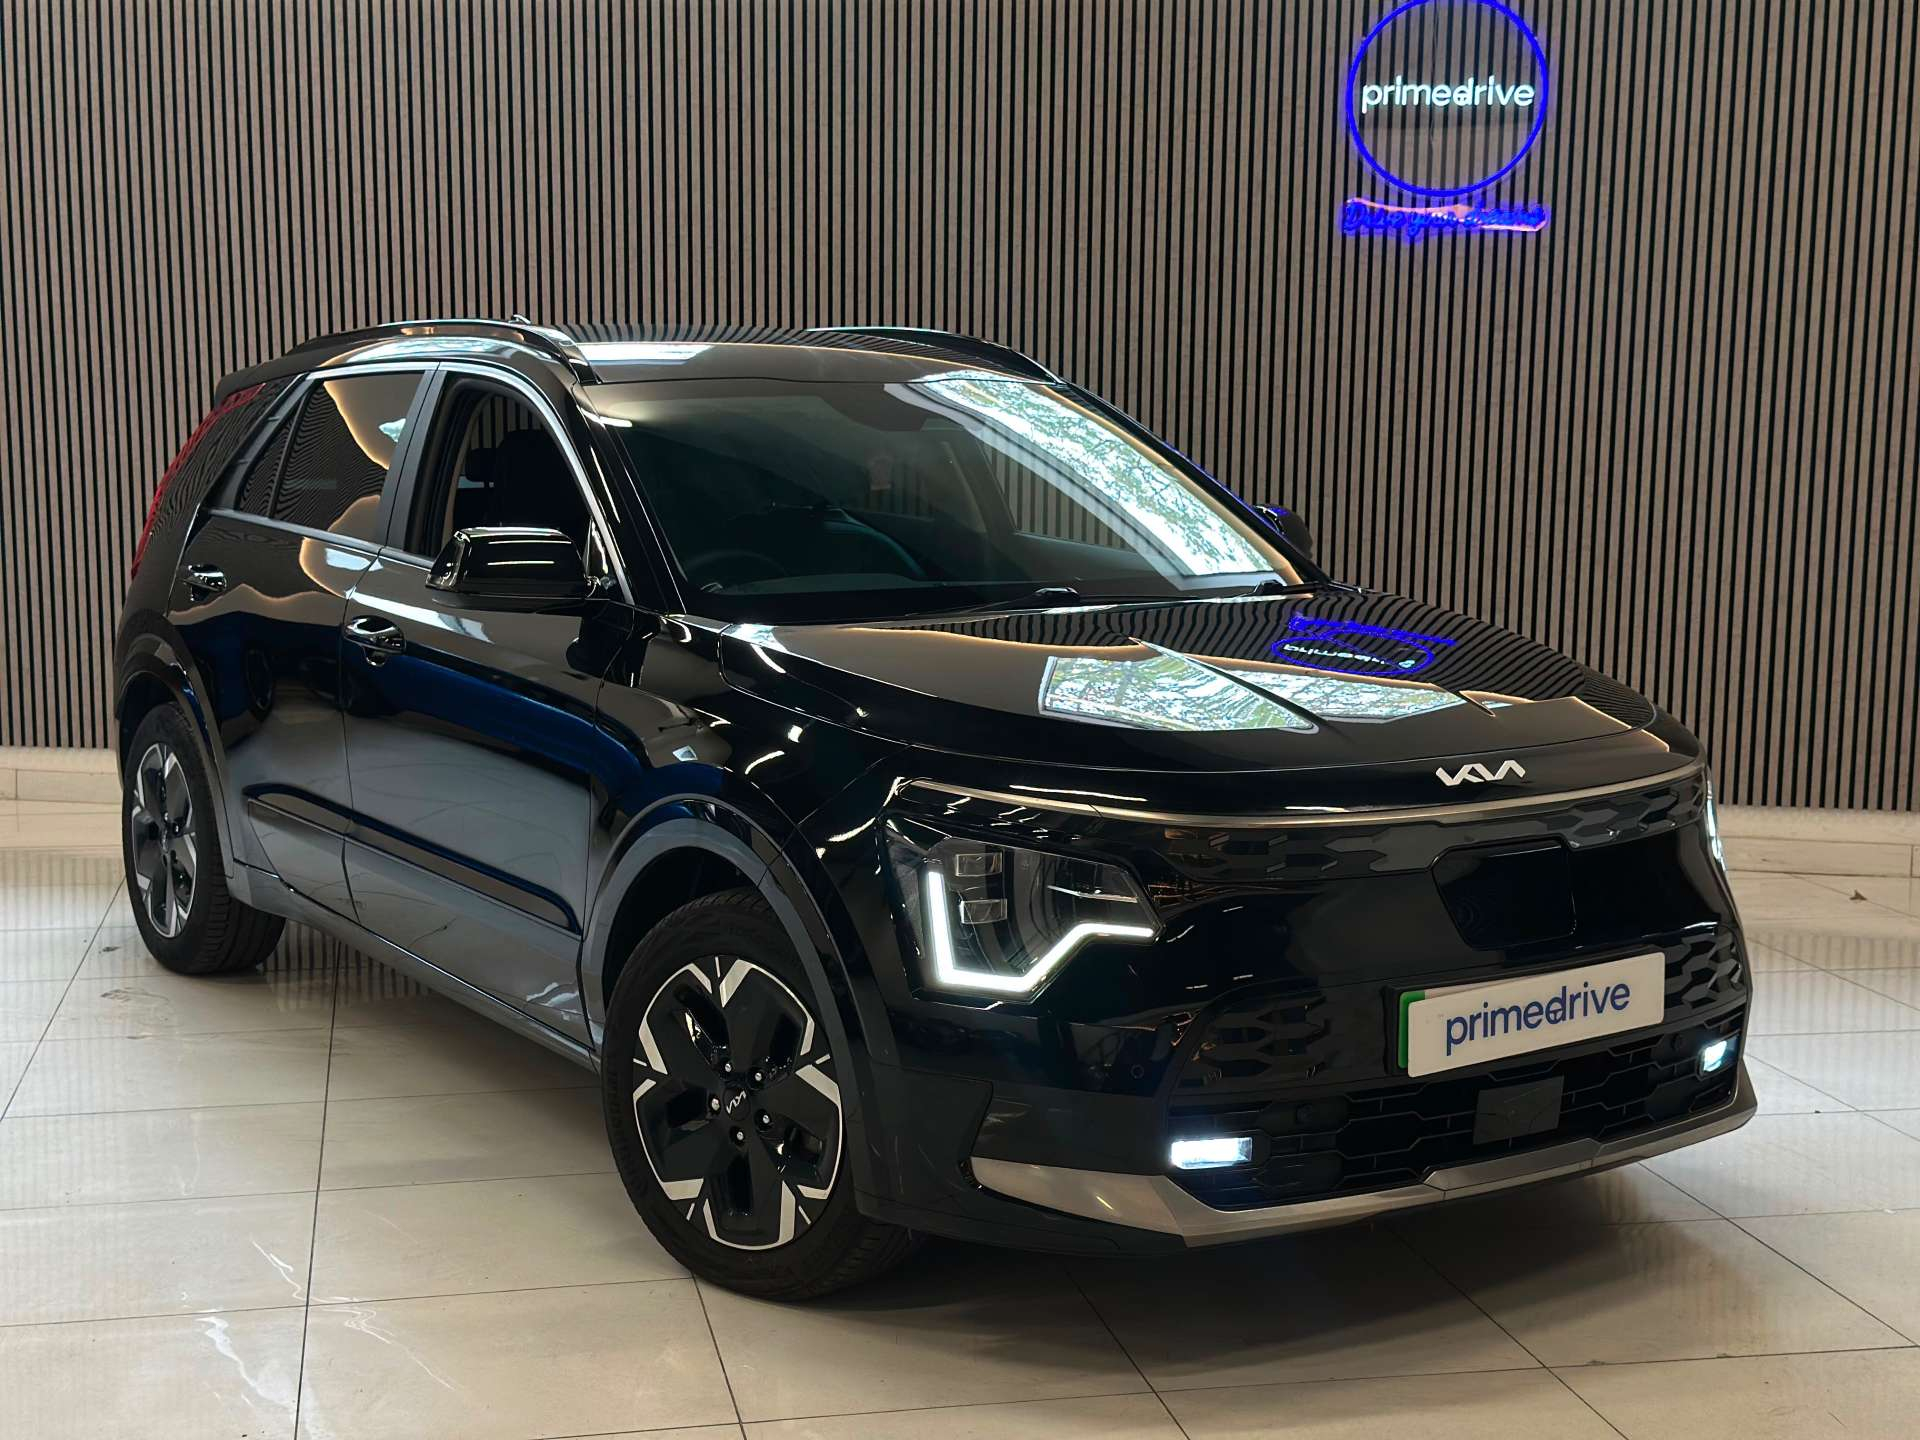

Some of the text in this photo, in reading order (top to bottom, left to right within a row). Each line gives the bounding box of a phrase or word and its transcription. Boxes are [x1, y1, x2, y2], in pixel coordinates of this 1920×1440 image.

[1361, 75, 1535, 114] primedrive
[1435, 759, 1526, 786] KIA
[1446, 981, 1631, 1056] primedrive
